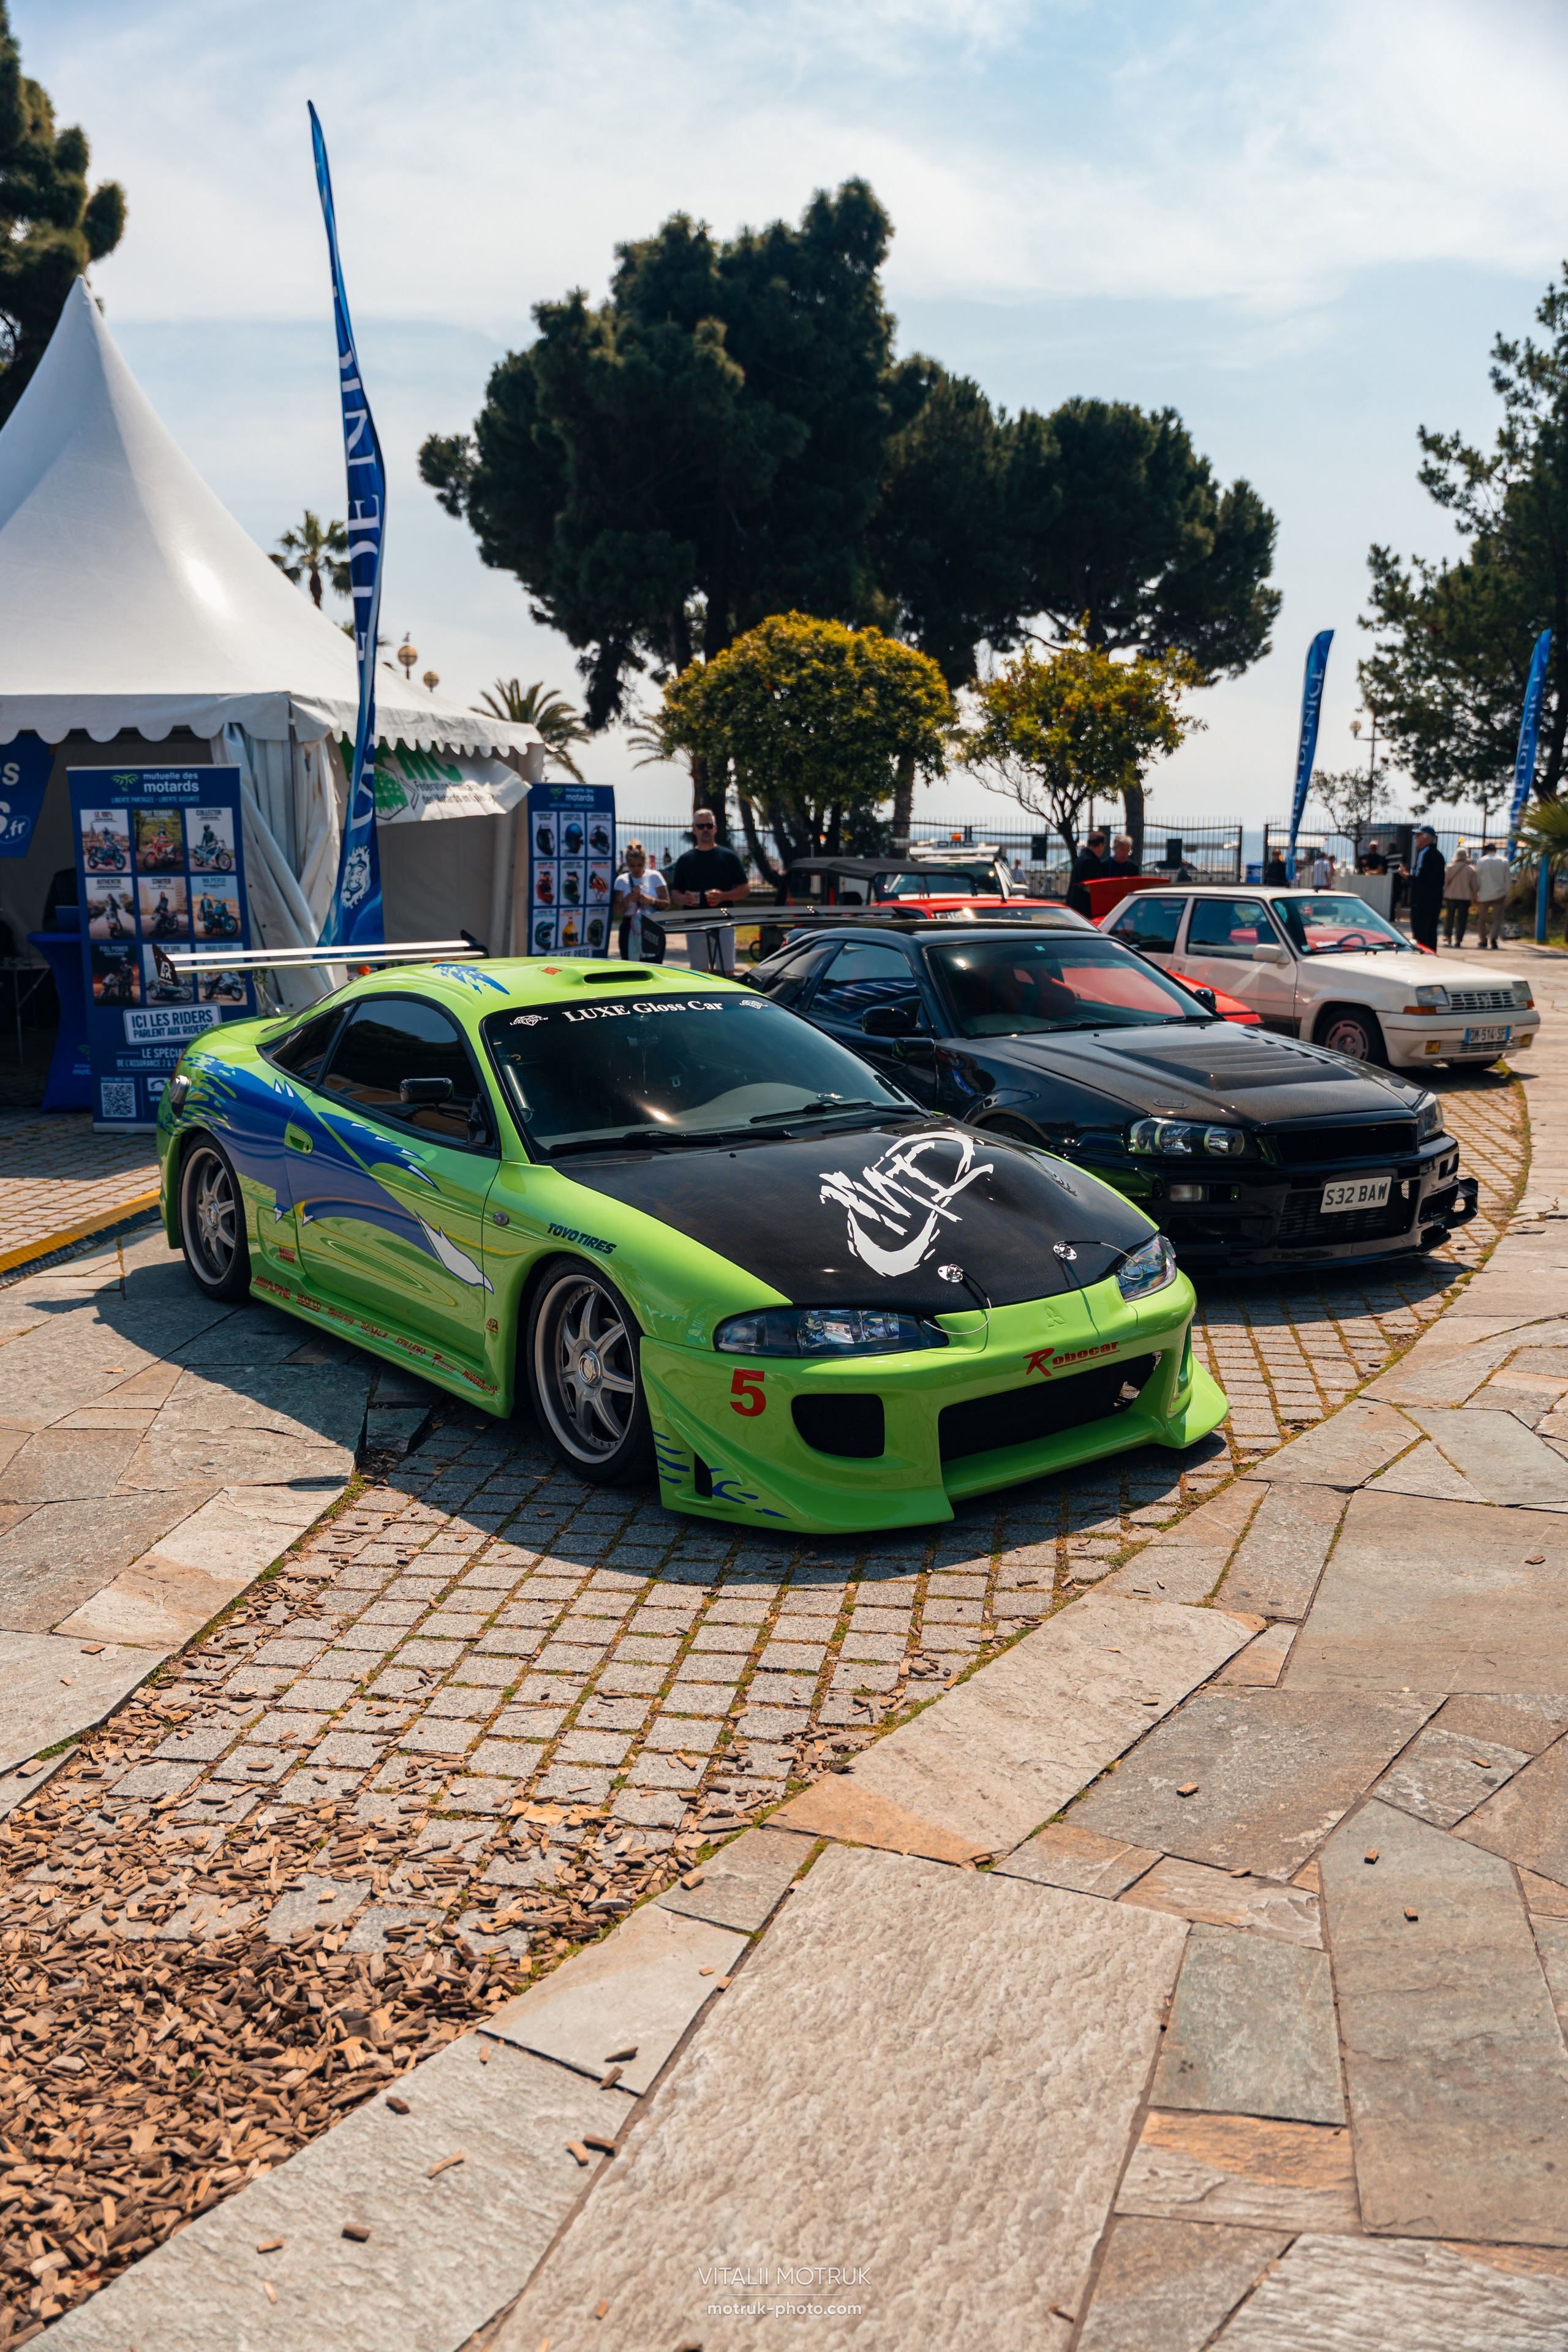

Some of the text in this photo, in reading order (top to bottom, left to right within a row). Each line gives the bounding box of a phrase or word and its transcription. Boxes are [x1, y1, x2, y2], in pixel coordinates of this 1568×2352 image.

[0, 763, 20, 786] S
[143, 772, 181, 780] mutuelle
[143, 780, 200, 793] motards
[565, 794, 595, 802] motards
[132, 1009, 213, 1028] ICI LES RIDERS
[562, 1000, 724, 1022] LUXE Gloss Car
[133, 1028, 165, 1038] PARLENT
[167, 1027, 182, 1036] AUX
[142, 1048, 151, 1058] LE
[1325, 1186, 1355, 1205] S32
[547, 1223, 617, 1254] TOYO TIRES
[1022, 1341, 1119, 1377] Robocar
[729, 1368, 767, 1417] 5
